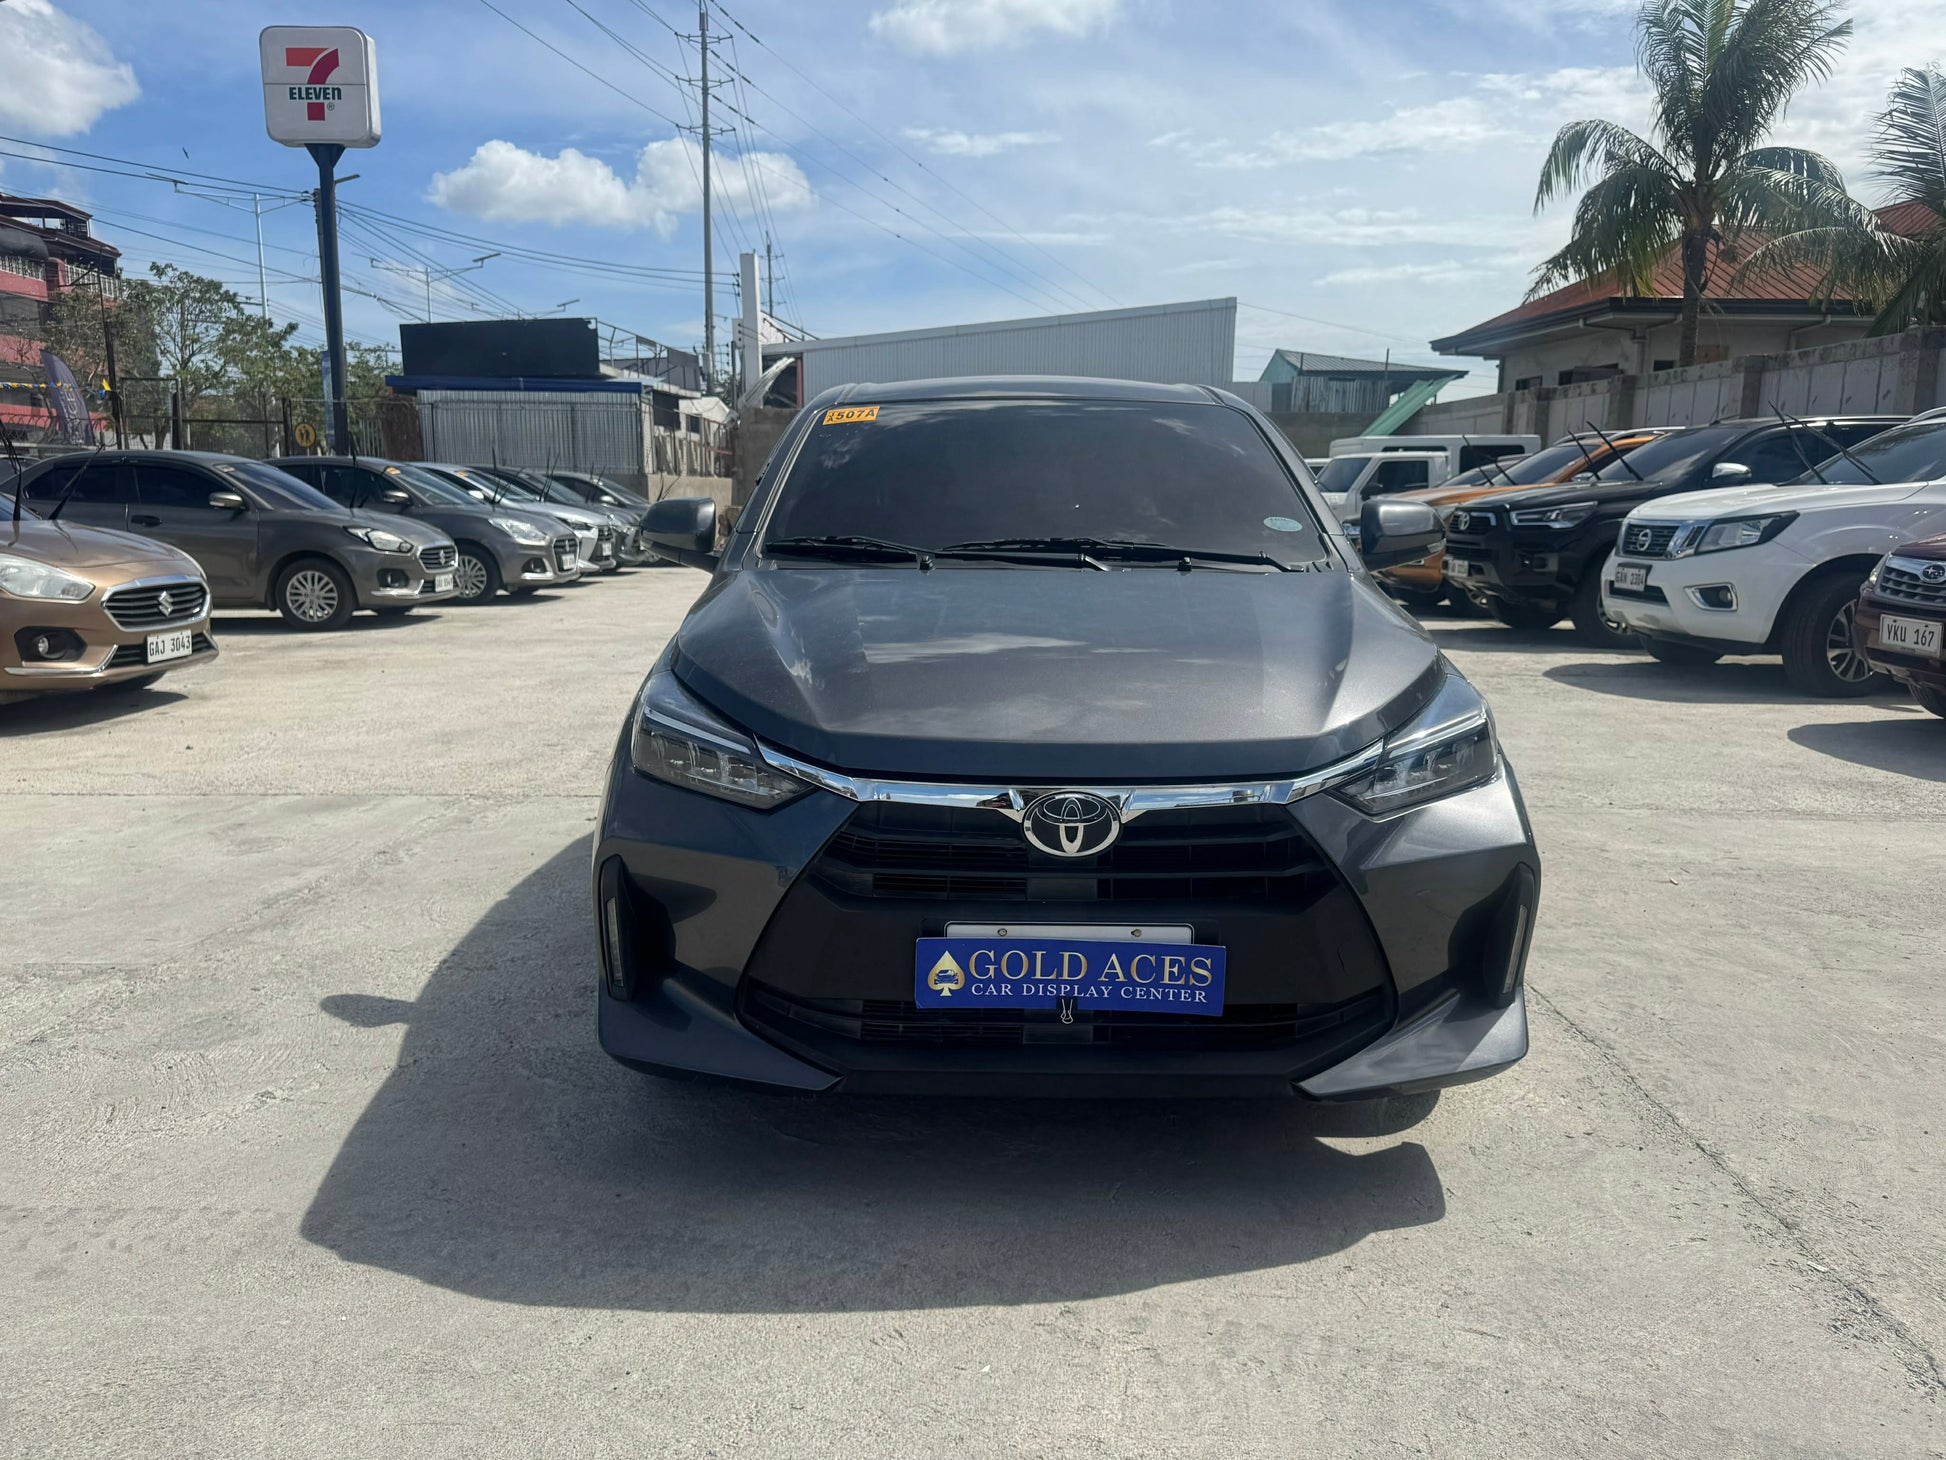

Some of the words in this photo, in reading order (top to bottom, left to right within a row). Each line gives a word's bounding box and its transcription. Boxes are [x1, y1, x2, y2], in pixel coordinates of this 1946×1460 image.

[285, 47, 340, 121] 7
[149, 639, 166, 657] GAJ
[170, 634, 191, 653] 3043
[1887, 623, 1907, 643] YKU
[1913, 628, 1935, 648] 167
[968, 949, 1088, 981] GOLD
[1098, 952, 1213, 987] ACES
[971, 983, 1012, 996] CAR
[1022, 983, 1113, 998] DISPLAY
[1121, 986, 1208, 1003] CENTER
